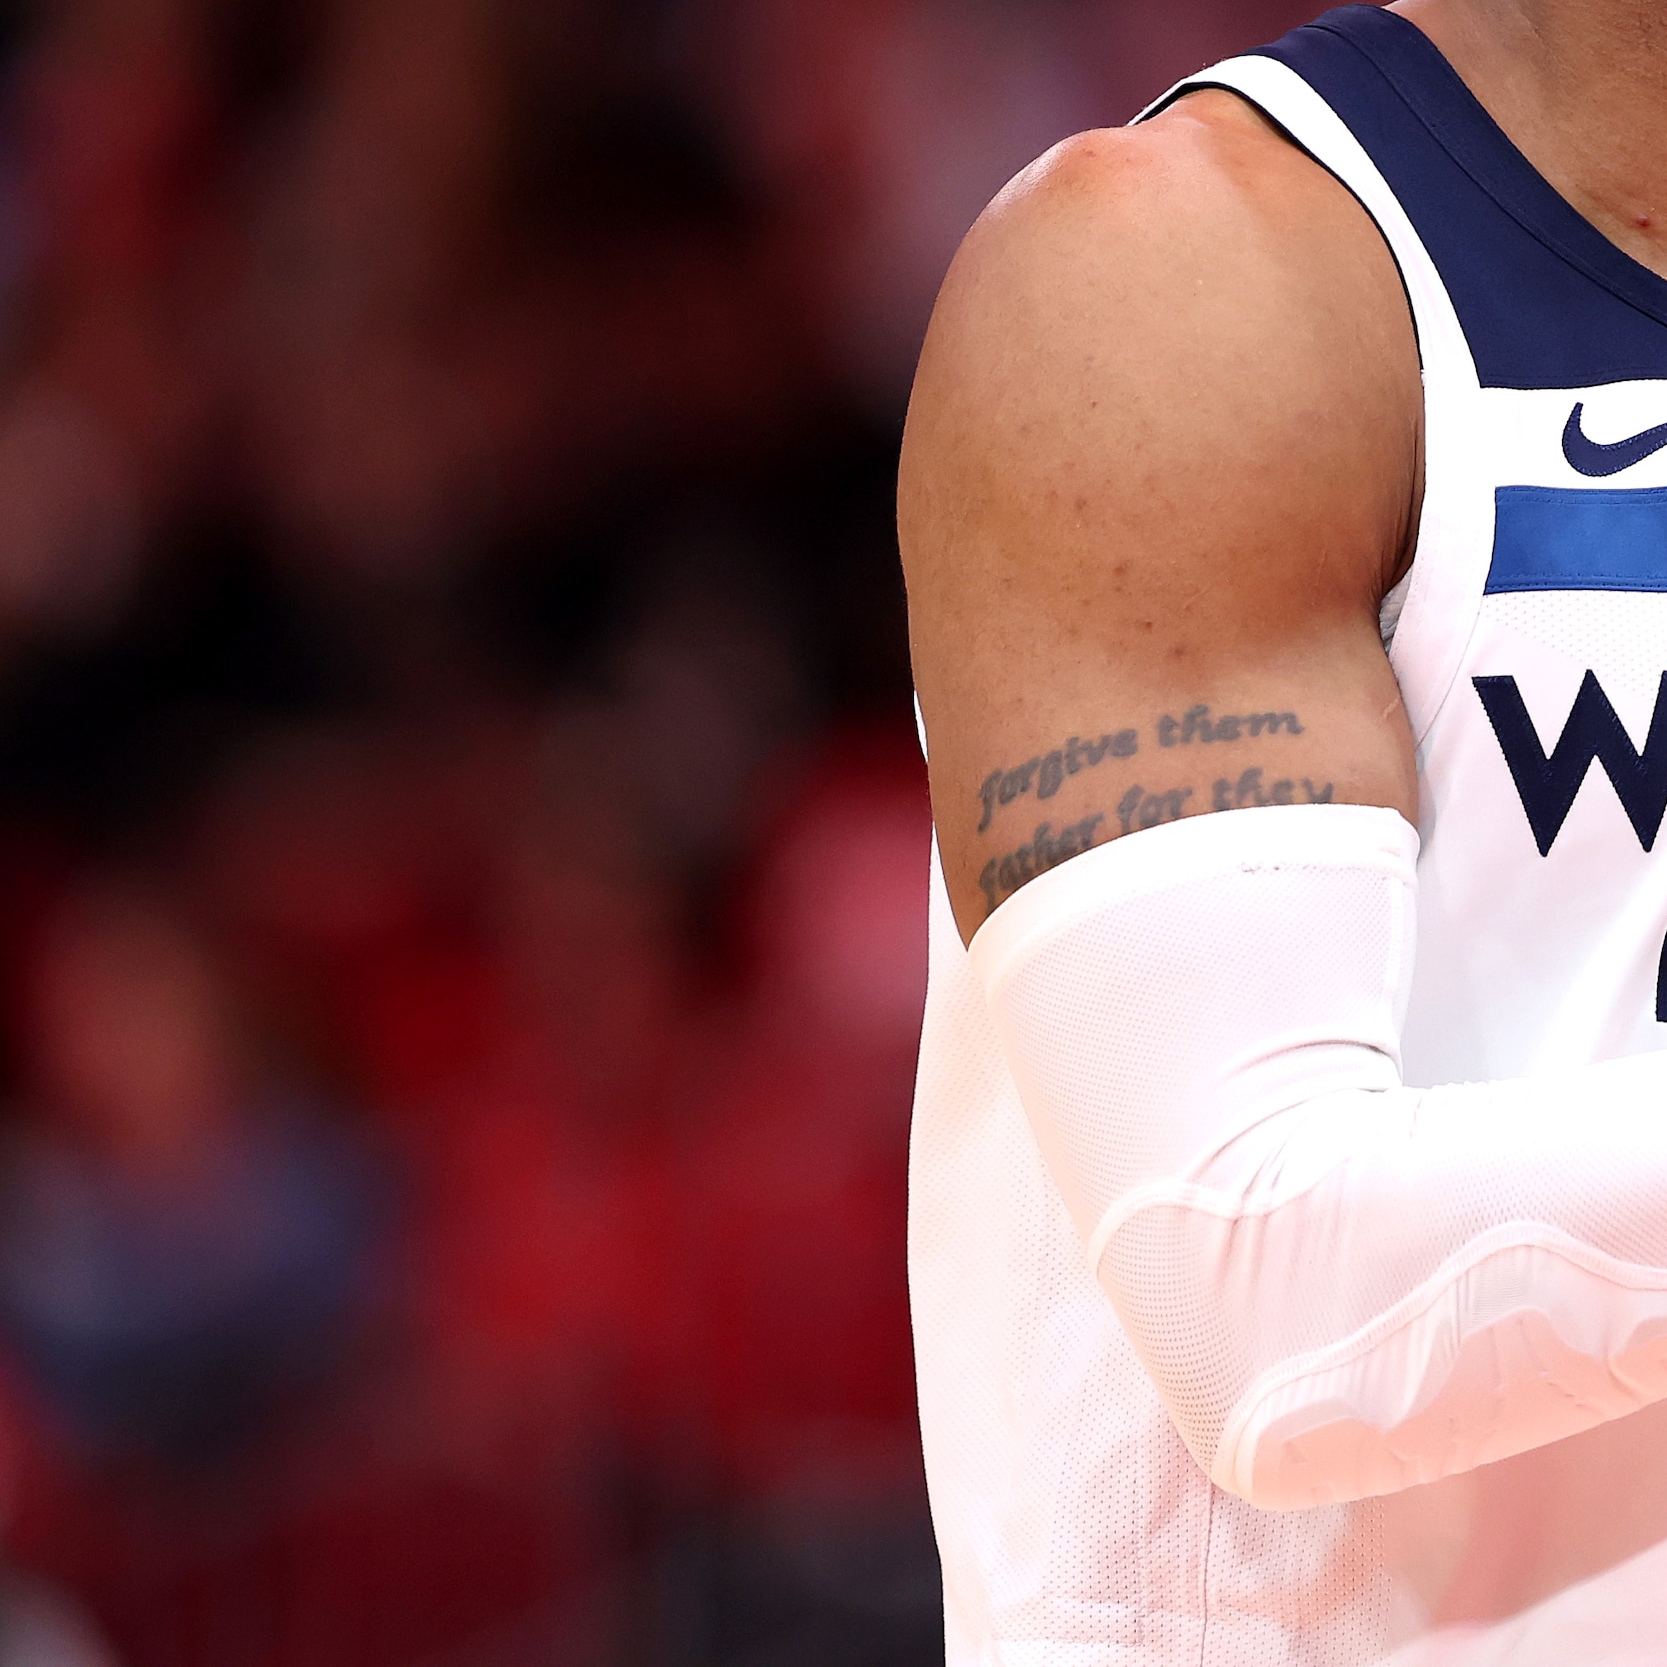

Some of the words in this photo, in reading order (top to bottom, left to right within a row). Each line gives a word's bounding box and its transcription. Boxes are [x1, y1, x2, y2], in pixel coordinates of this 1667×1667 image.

[977, 727, 1139, 833] forgive
[1157, 703, 1305, 748] them
[1117, 783, 1193, 835] for
